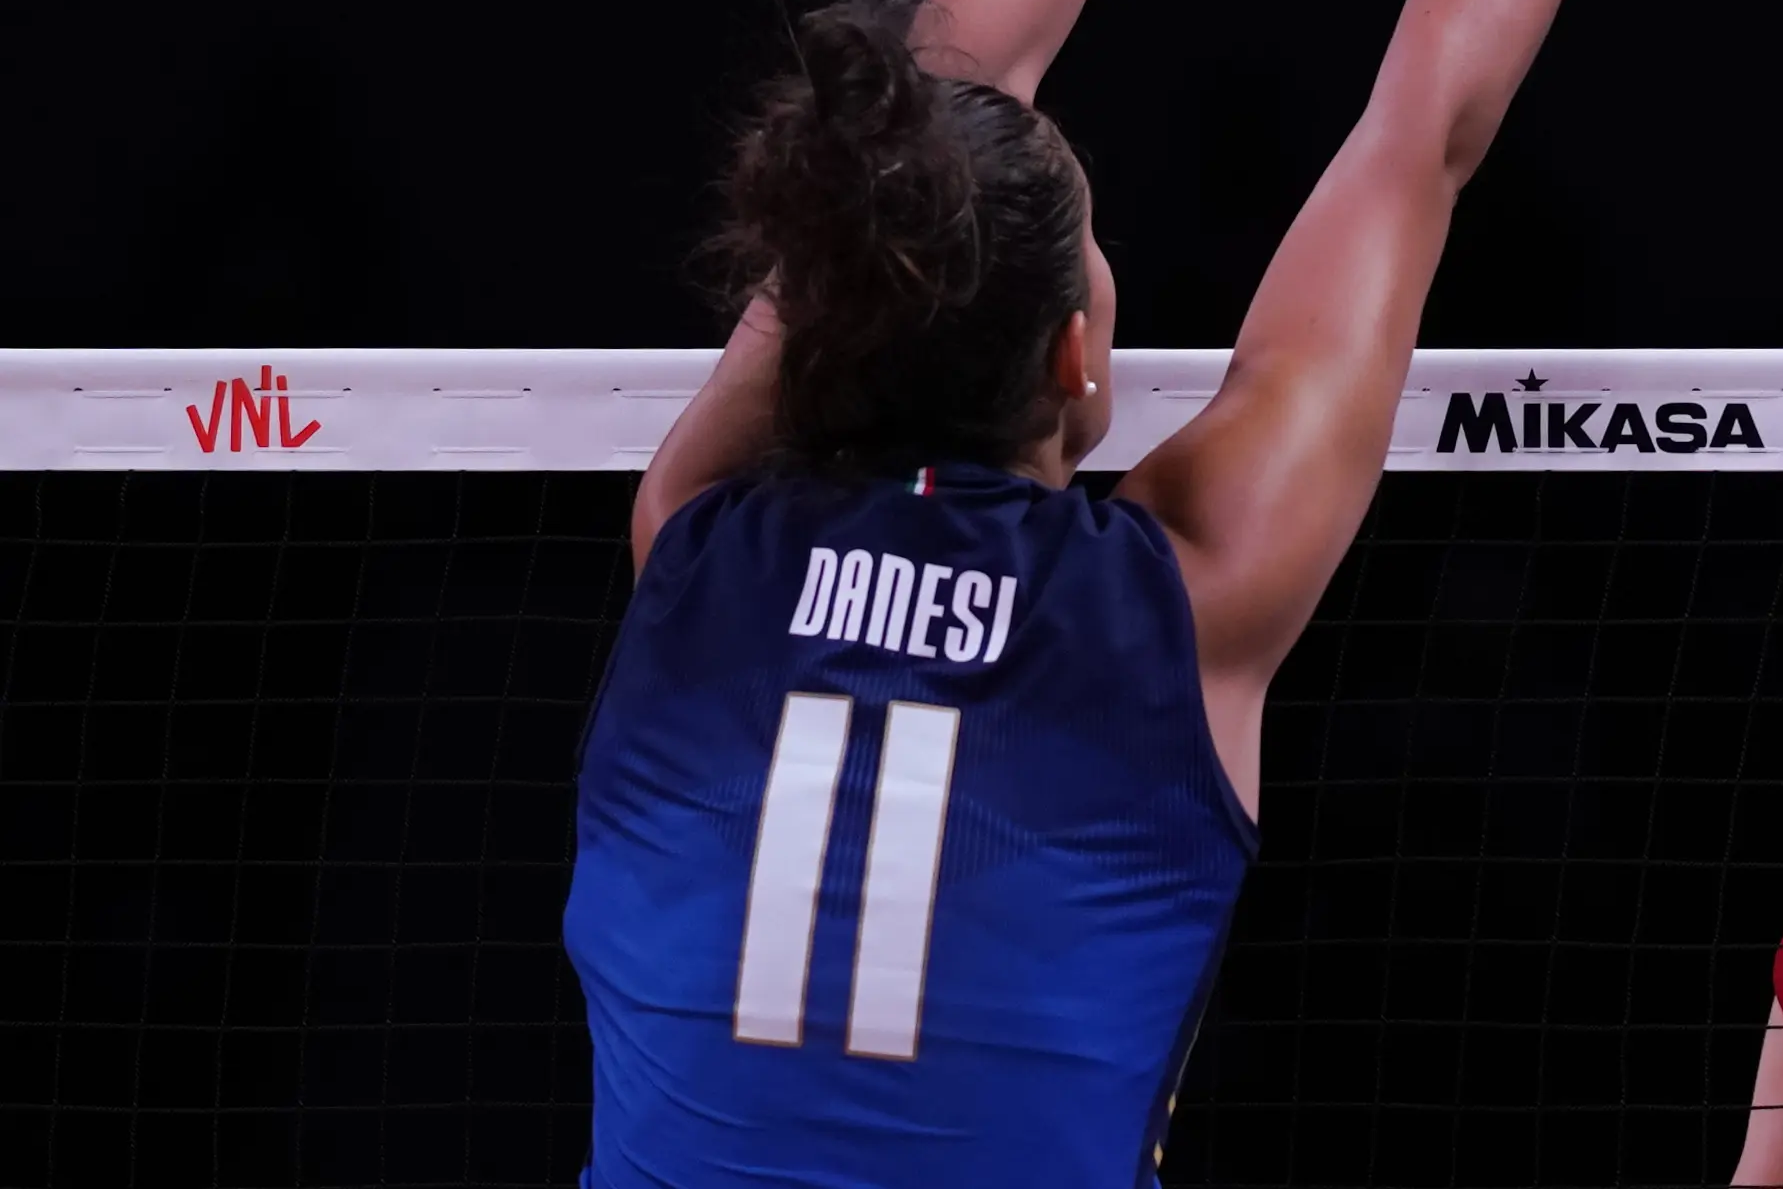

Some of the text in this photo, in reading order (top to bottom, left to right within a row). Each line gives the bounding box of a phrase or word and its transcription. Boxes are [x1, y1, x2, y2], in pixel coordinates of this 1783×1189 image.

[185, 364, 322, 453] VNL
[1436, 367, 1766, 454] MIKASA
[788, 546, 1018, 664] DANESI
[732, 691, 961, 1062] 11
